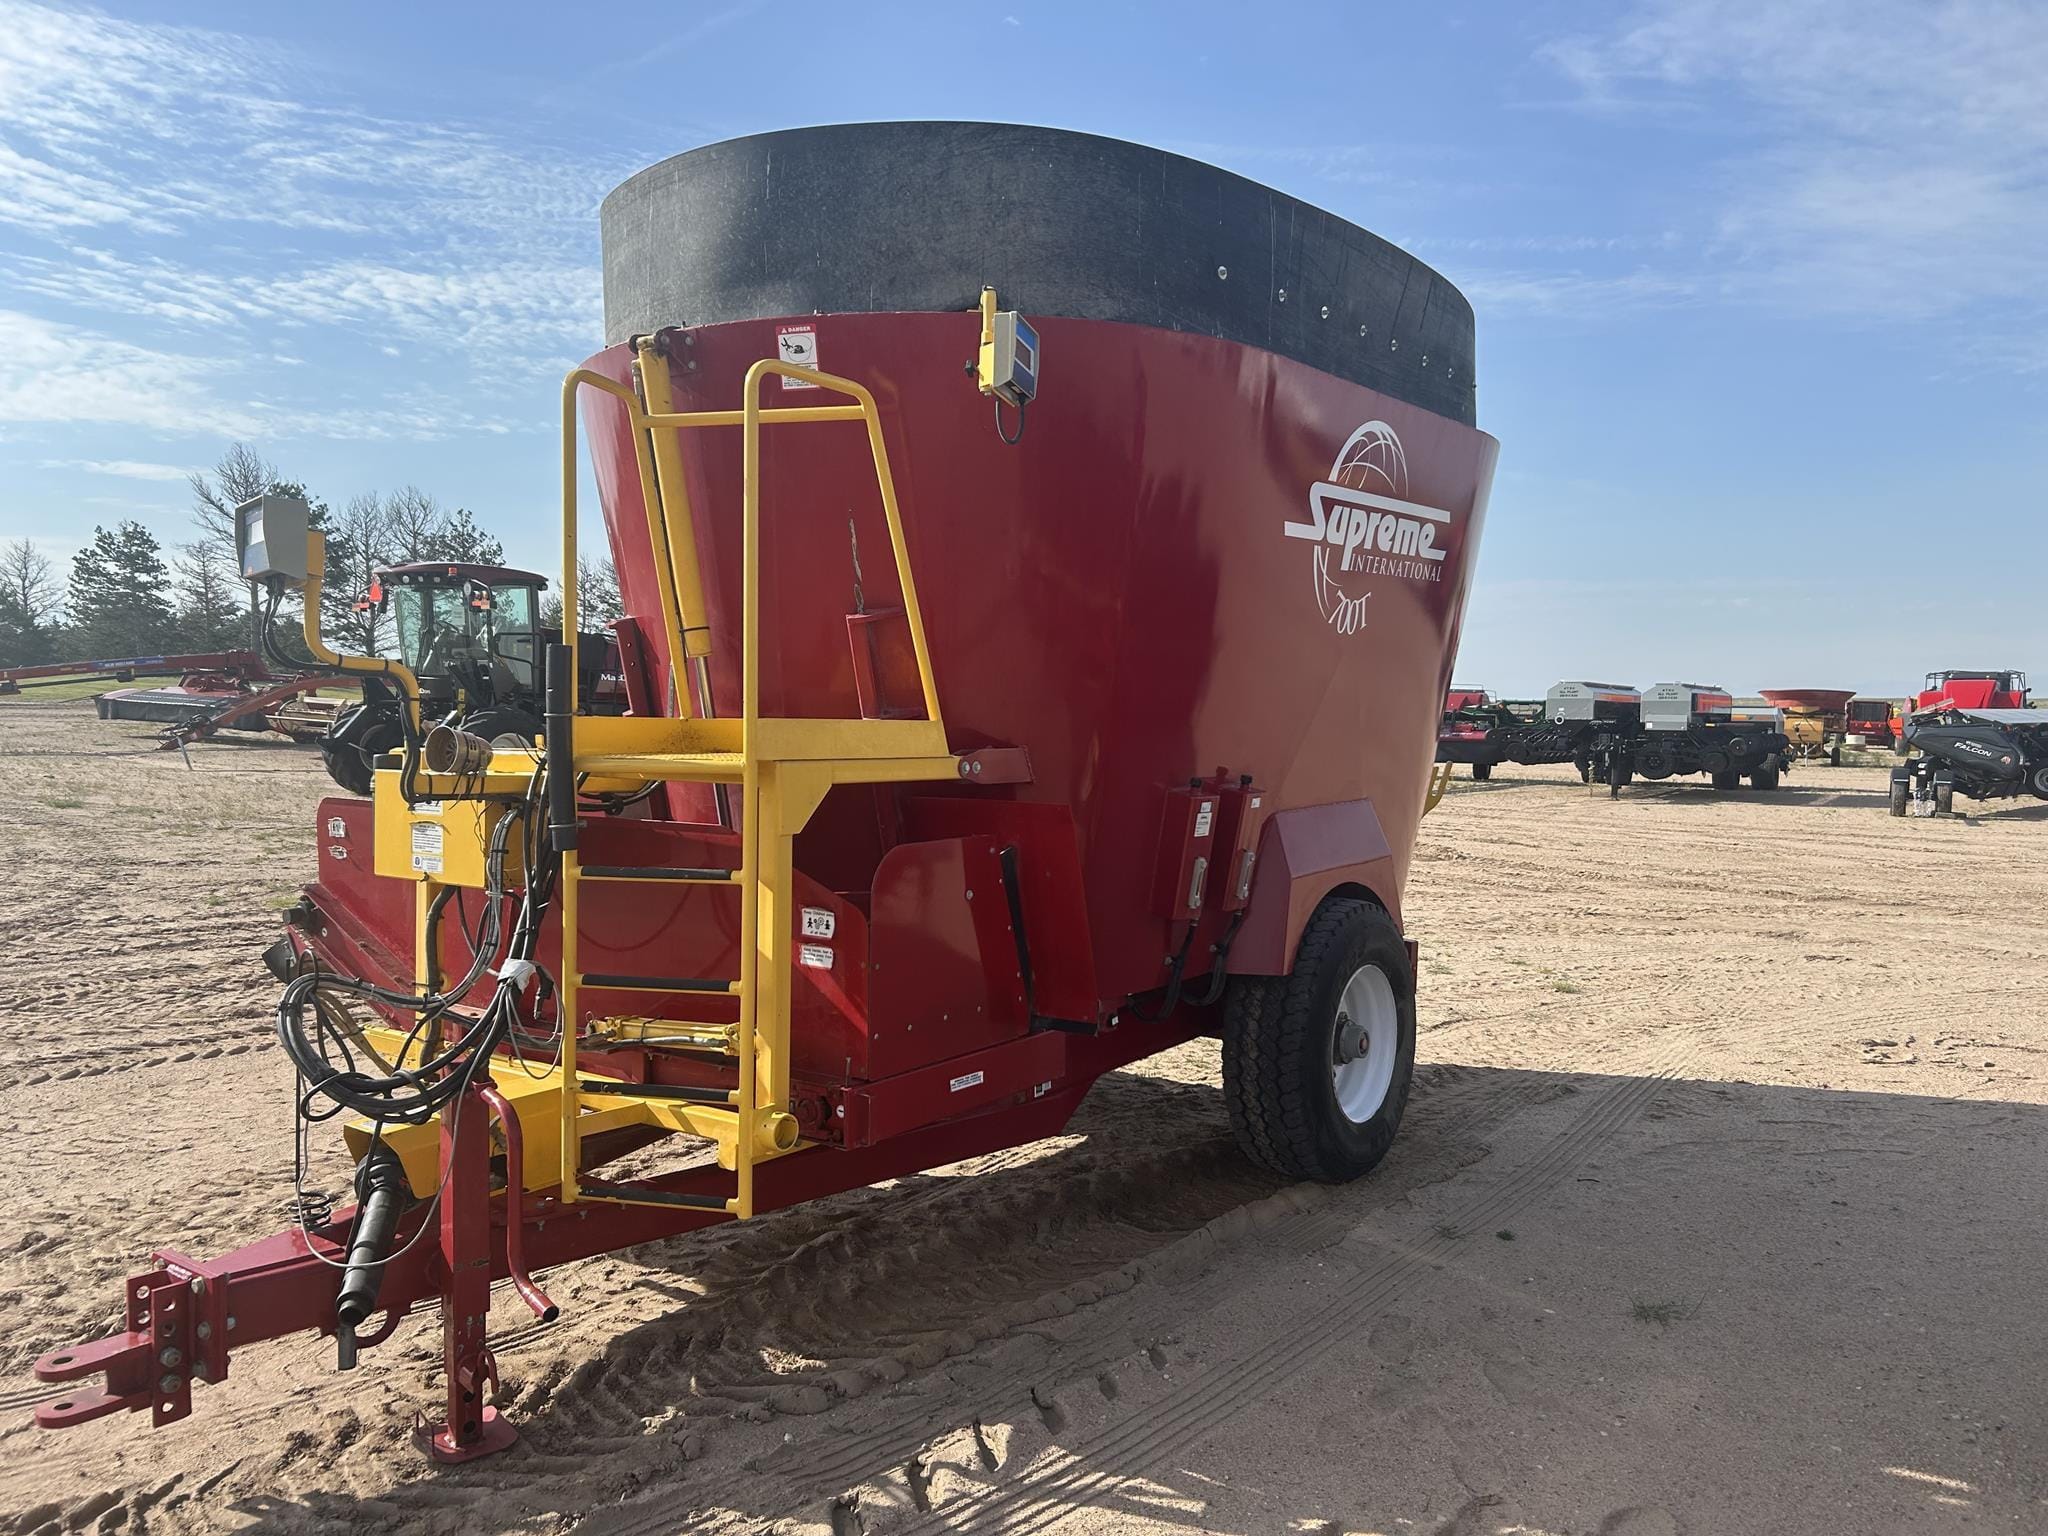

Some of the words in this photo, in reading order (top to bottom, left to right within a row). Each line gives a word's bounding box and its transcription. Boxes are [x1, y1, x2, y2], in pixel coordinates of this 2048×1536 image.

[1284, 481, 1451, 571] Supreme
[1350, 552, 1443, 582] INTERNATIONAL
[1954, 742, 1992, 757] FALCON
